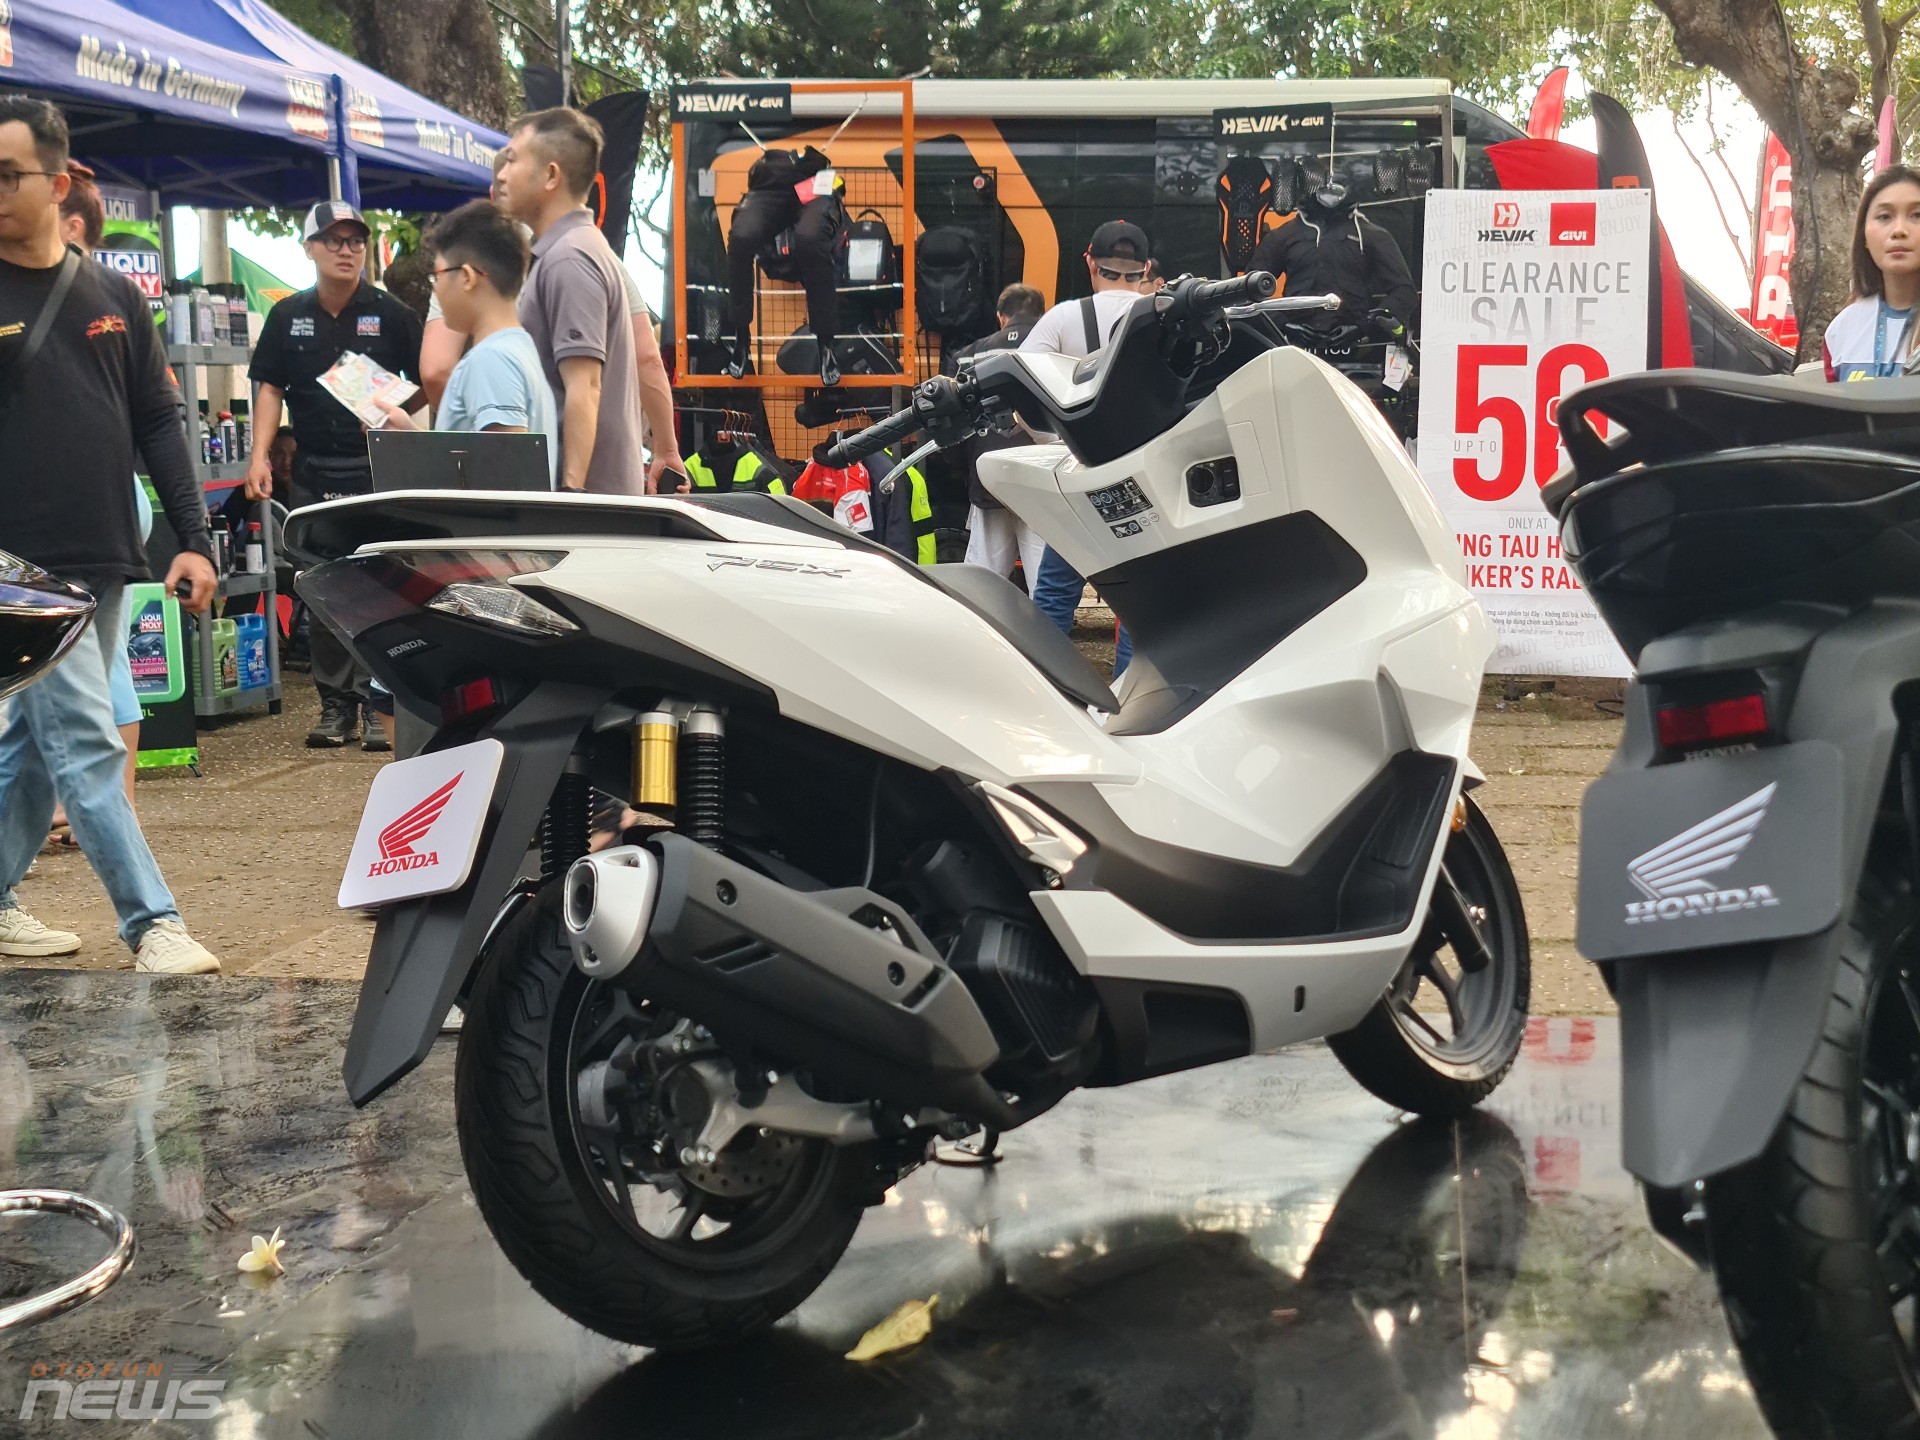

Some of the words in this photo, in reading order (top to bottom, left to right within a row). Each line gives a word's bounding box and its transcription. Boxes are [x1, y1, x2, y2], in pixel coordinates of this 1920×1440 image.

[76, 34, 136, 87] Made
[139, 48, 162, 92] in
[164, 56, 246, 118] Germany
[677, 93, 746, 112] HEVIK
[760, 96, 784, 108] GIVI
[1221, 114, 1288, 135] HEVIK
[1301, 116, 1325, 127] GIVI
[1478, 230, 1535, 242] HEVIK
[1558, 230, 1588, 241] GIVI
[1441, 262, 1631, 294] CLEARANCE
[1508, 517, 1534, 529] ONLY
[1536, 518, 1549, 530] AT
[1499, 535, 1539, 558] TAU
[1466, 565, 1534, 589] IKER'S
[1541, 566, 1583, 590] RAL
[386, 638, 428, 658] HONDA
[367, 851, 440, 878] HONDA
[1624, 884, 1780, 925] HONDA
